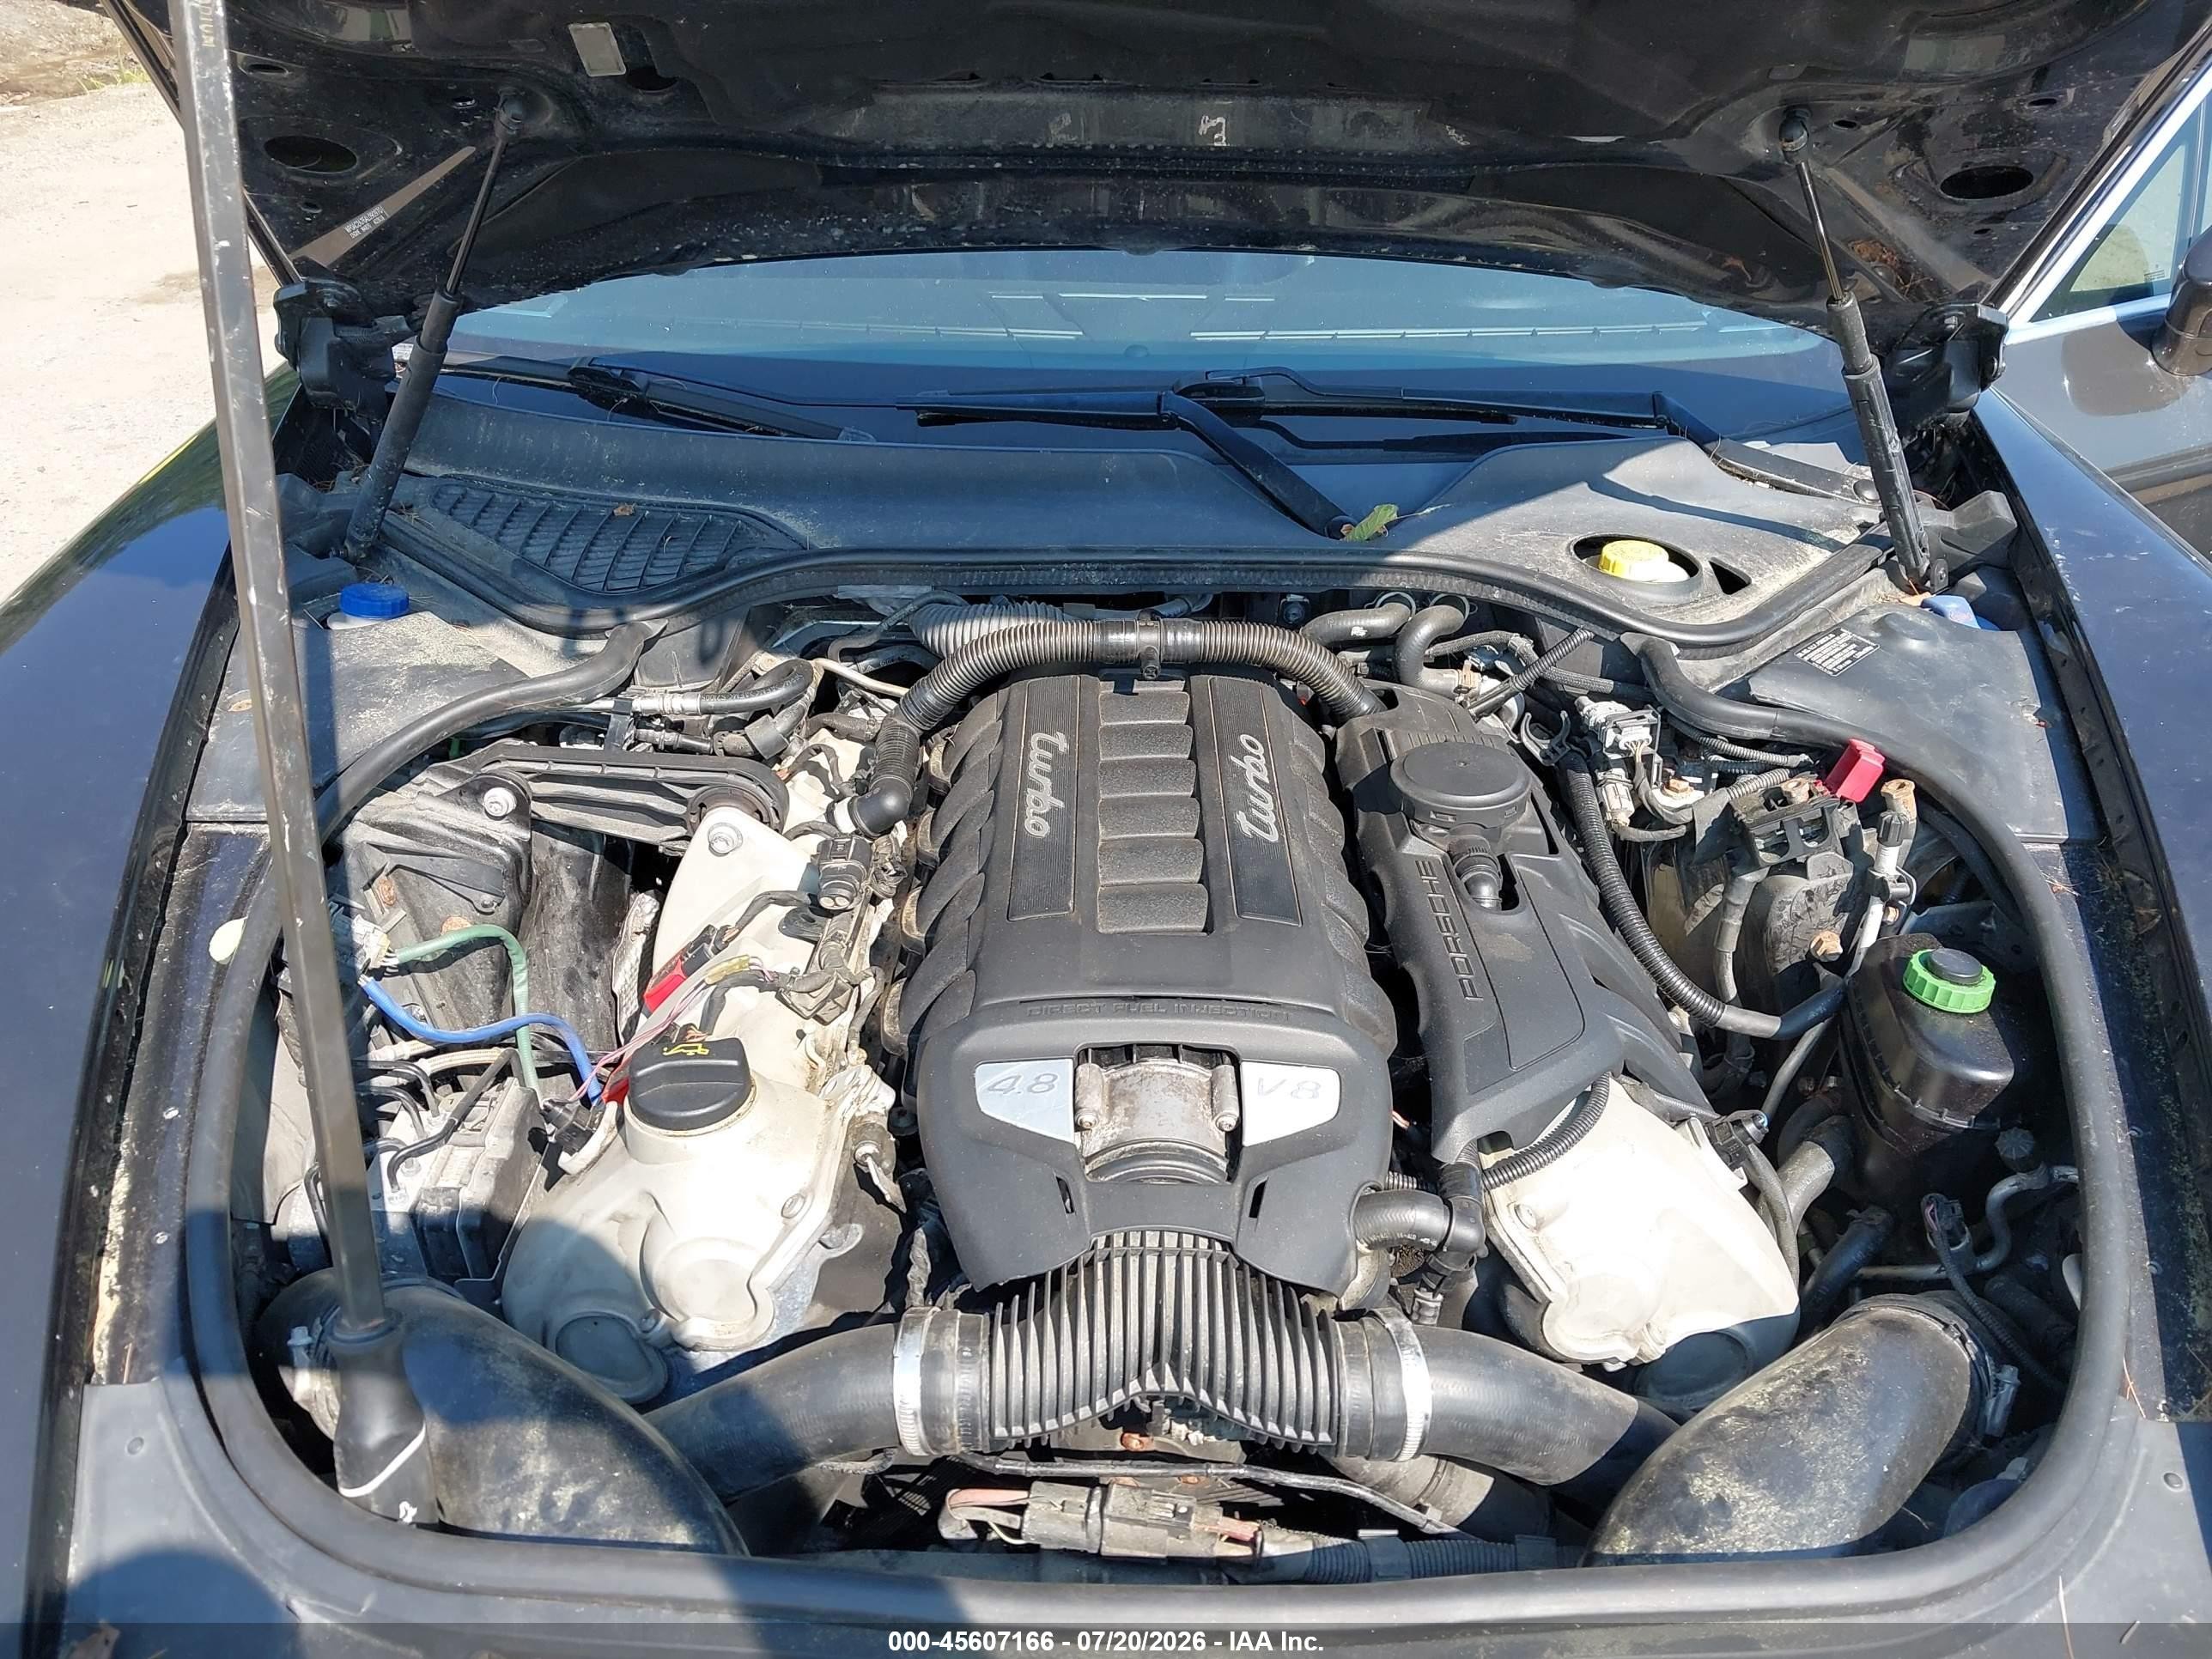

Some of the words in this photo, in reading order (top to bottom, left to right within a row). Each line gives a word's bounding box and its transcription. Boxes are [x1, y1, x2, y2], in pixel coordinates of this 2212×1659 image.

[1023, 731, 1070, 839] turbo
[1230, 733, 1279, 842] turbo
[1414, 860, 1484, 1001] PORSCHE
[1026, 1002, 1106, 1017] DIRECT
[1112, 1001, 1168, 1014] FUEL
[1174, 1003, 1292, 1021] INJECTION
[987, 1073, 1059, 1095] 4.8
[1257, 1077, 1322, 1100] V8
